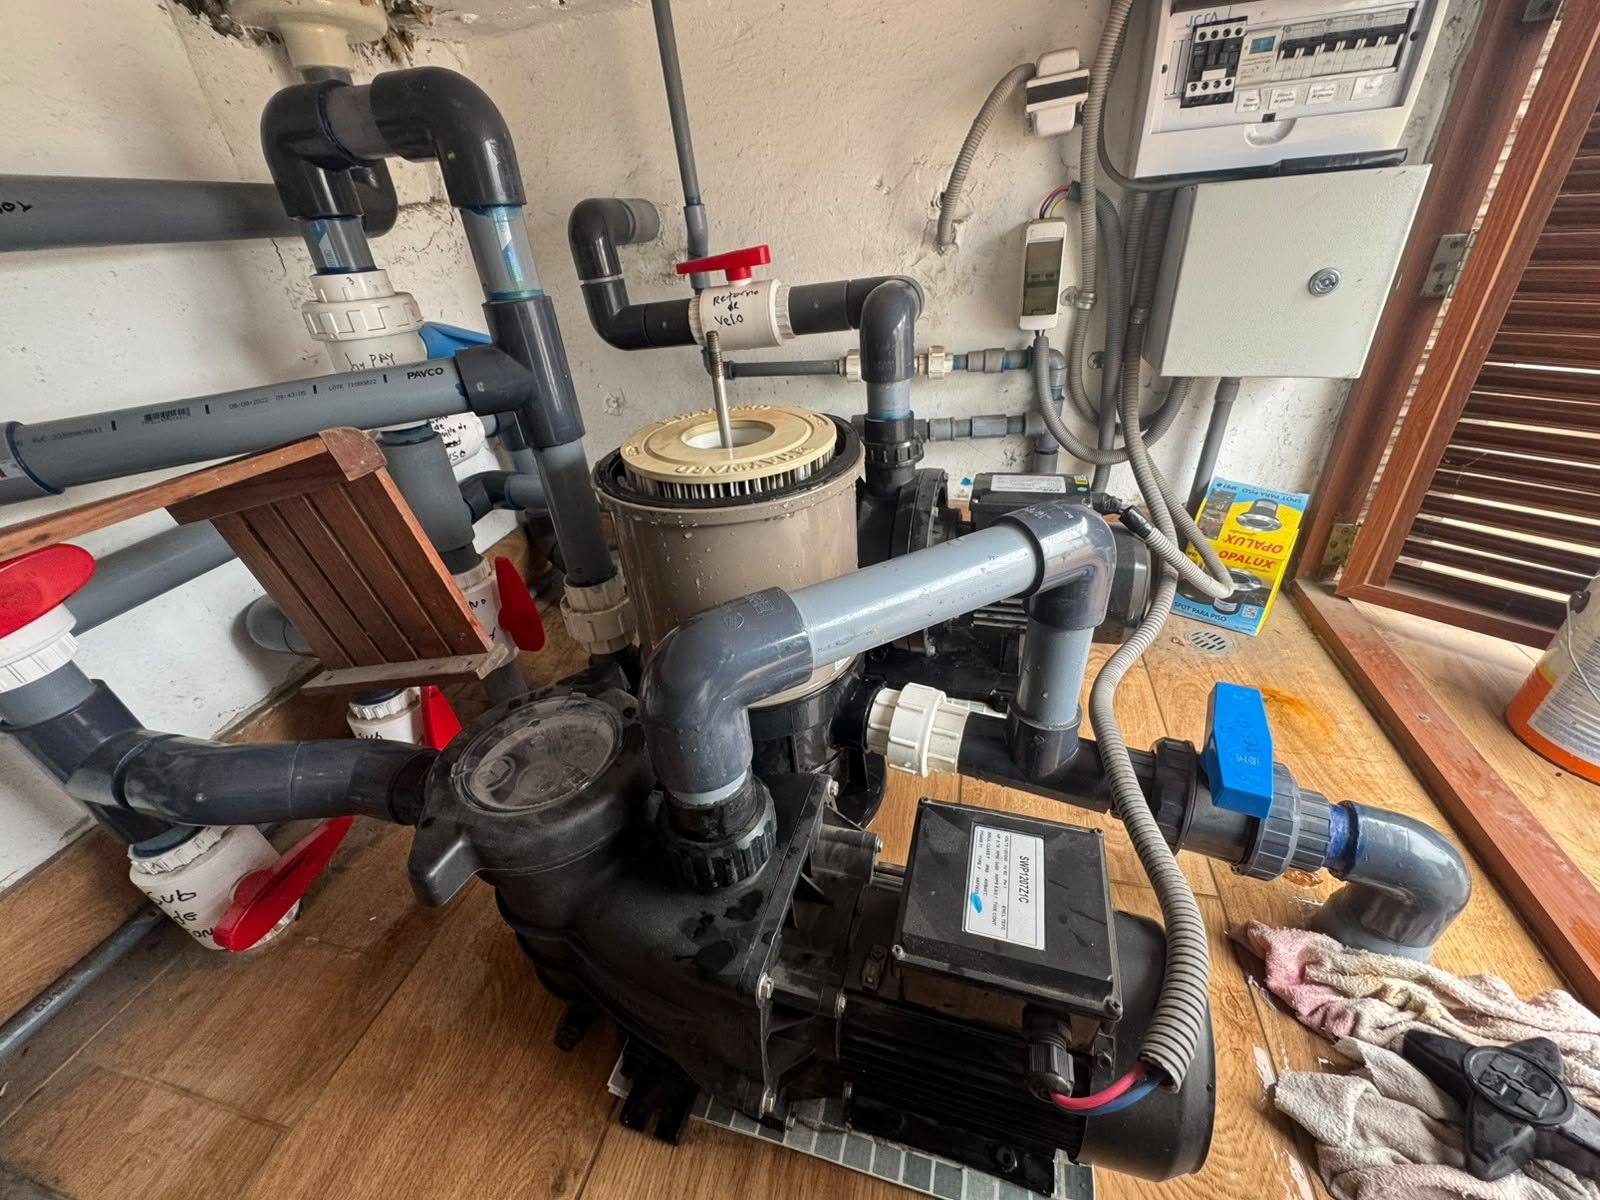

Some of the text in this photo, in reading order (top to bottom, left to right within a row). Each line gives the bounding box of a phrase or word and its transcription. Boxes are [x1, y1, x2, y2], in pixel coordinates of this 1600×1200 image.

[407, 367, 444, 380] PAVCO
[1224, 533, 1284, 554] OPALUX
[1218, 550, 1275, 569] OPALUX
[1210, 613, 1227, 623] PISO
